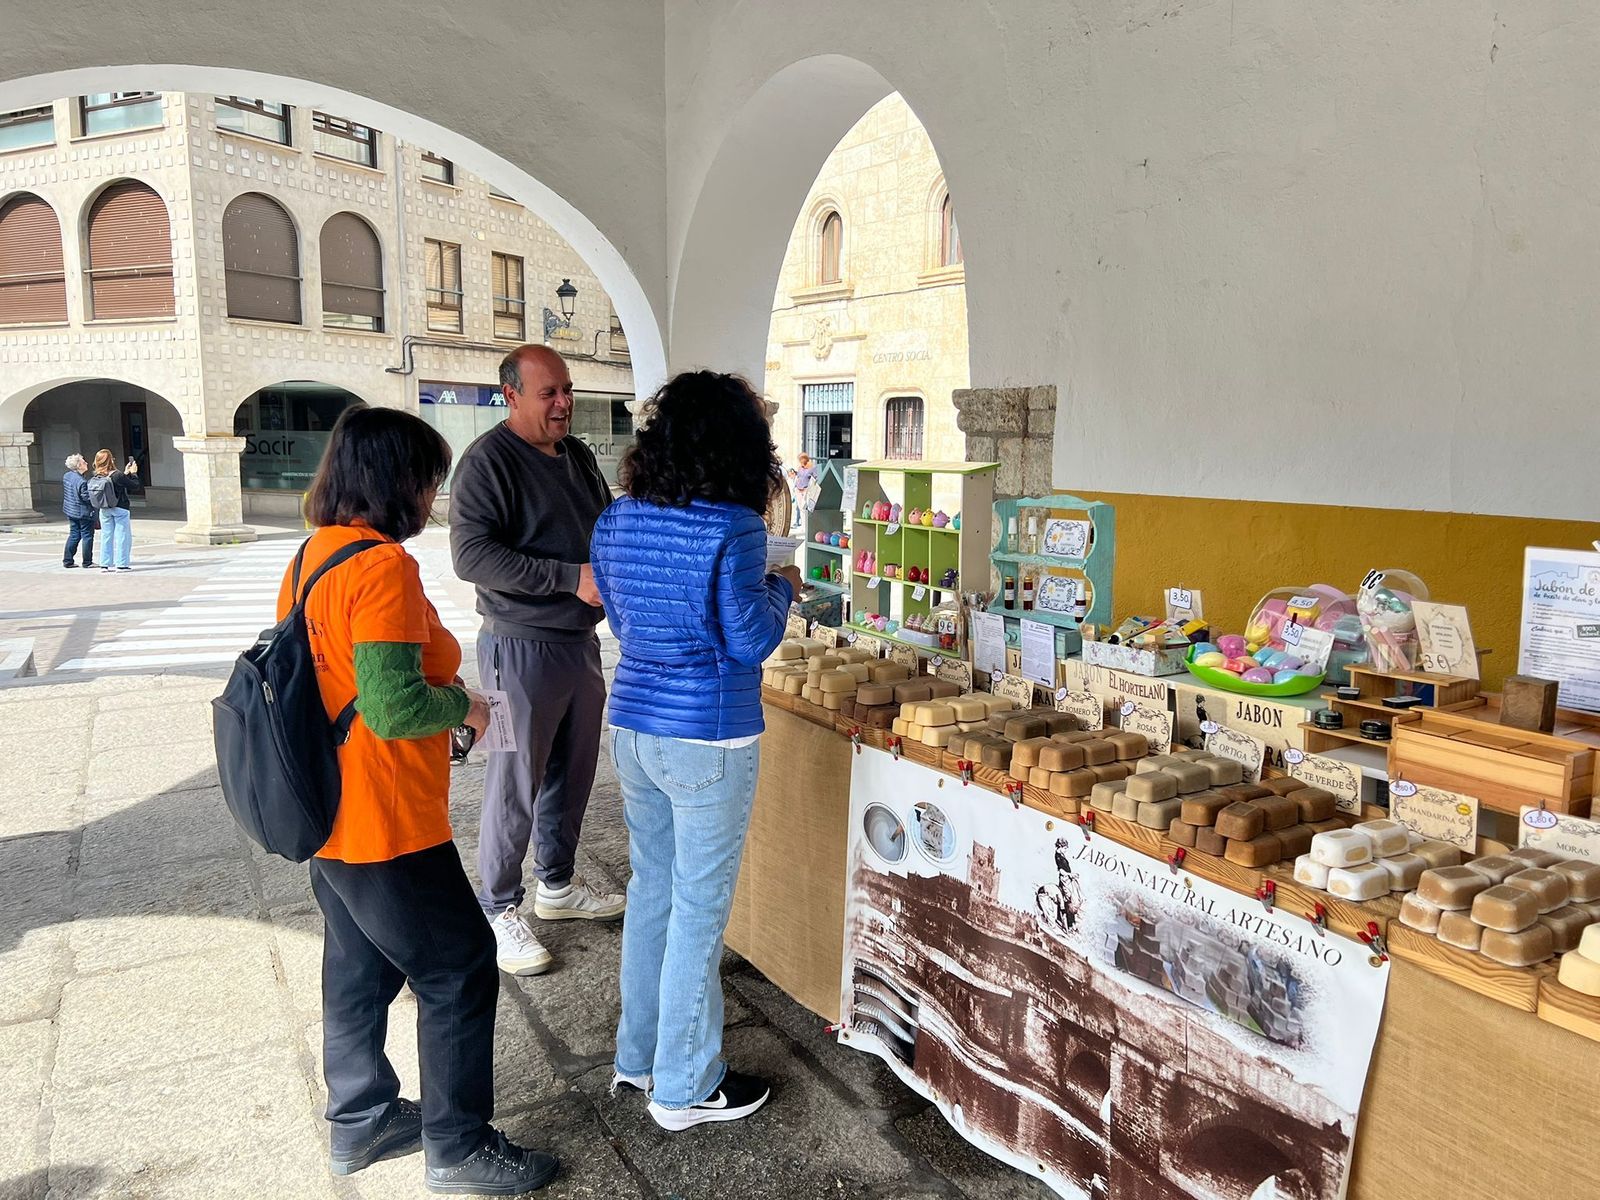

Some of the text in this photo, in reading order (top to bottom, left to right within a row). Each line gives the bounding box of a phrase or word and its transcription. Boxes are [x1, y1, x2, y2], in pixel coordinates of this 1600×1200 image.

[873, 352, 904, 364] CENTRO
[438, 390, 458, 404] AXA
[489, 393, 507, 405] AXA
[245, 434, 295, 455] Sacir
[1534, 580, 1595, 596] Jabón de
[1173, 592, 1189, 603] 3,50
[1284, 625, 1300, 638] 3,50
[1109, 671, 1165, 701] EL HORTELANO
[1065, 706, 1091, 716] ROMERO
[1236, 701, 1283, 728] JABON
[1136, 722, 1157, 733] ROSAS
[1219, 744, 1247, 760] ORTIGA
[1304, 772, 1344, 789] TE VERDE
[1409, 807, 1456, 824] MANDARINA
[1556, 842, 1590, 856] MORAS
[1072, 845, 1342, 966] JABÓN NATURAL ARTESANO
